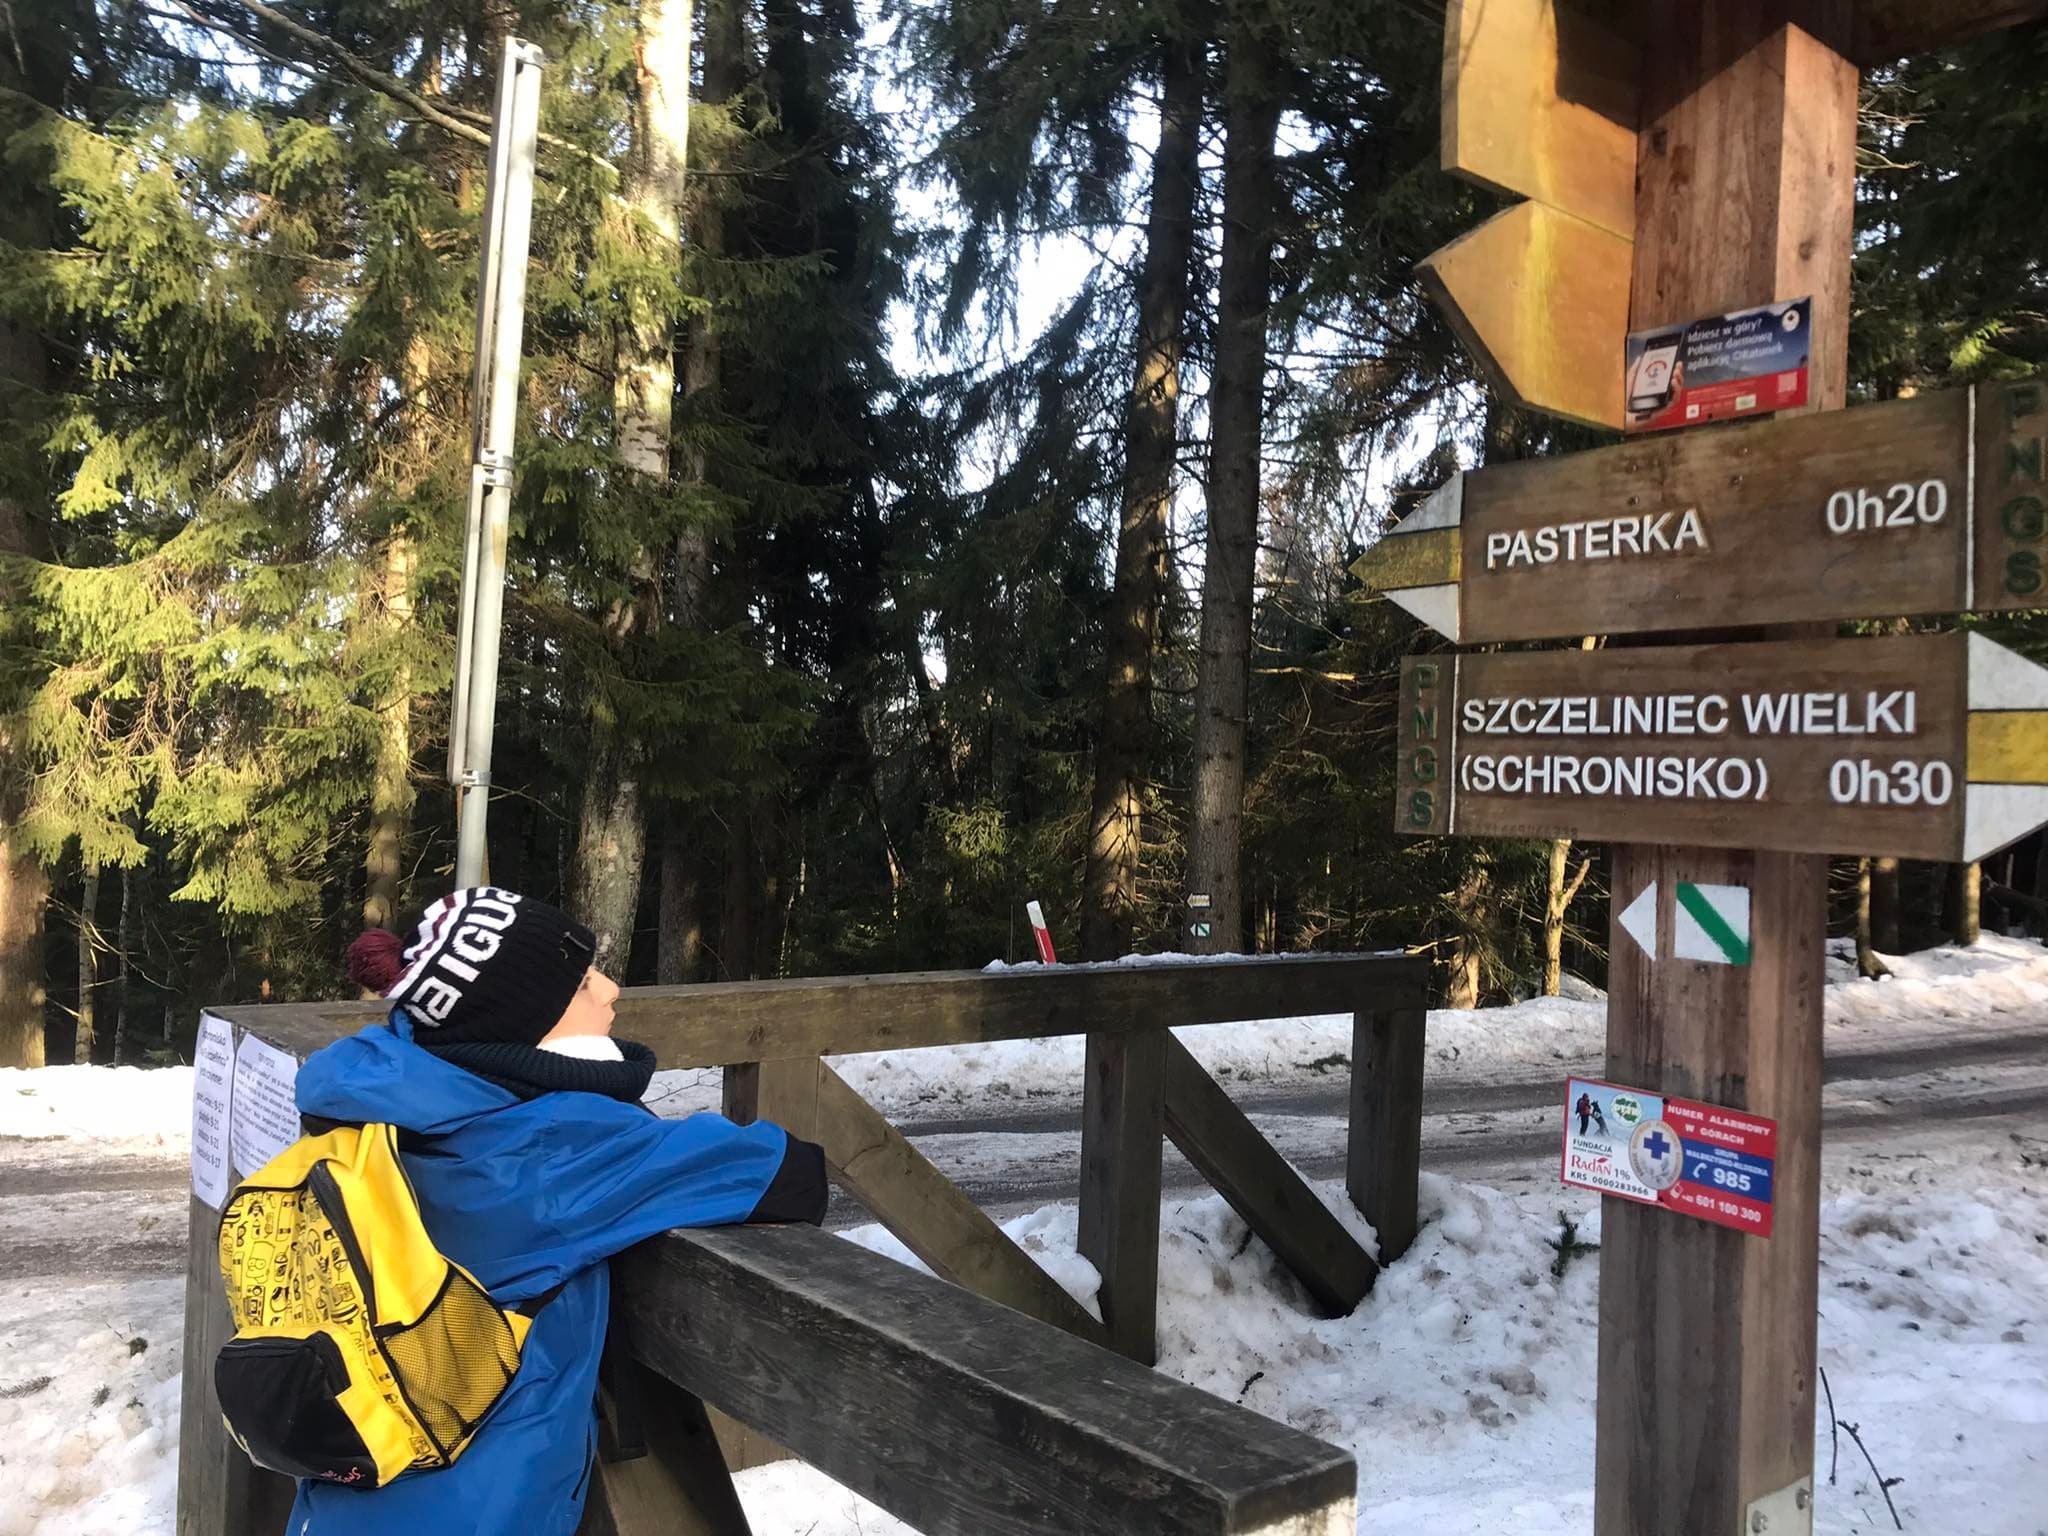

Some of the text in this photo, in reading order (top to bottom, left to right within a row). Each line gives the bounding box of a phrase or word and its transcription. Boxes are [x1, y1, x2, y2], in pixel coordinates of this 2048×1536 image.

[1487, 479, 1949, 570] PASTERKA 0h20
[1462, 691, 1917, 736] SZCZELINIEC WIELKI
[1461, 754, 1953, 806] (SCHRONISKO) 0h30
[1667, 1104, 1771, 1137] NUMER ALARMOWY
[1685, 1124, 1695, 1134] W
[1573, 1138, 1613, 1154] FUNDACJA
[1570, 1170, 1588, 1182] KRS
[1614, 1168, 1631, 1181] 1%
[1713, 1168, 1751, 1192] 985
[1696, 1195, 1715, 1210] 601
[1719, 1201, 1738, 1216] 100
[1740, 1207, 1762, 1223] 300
